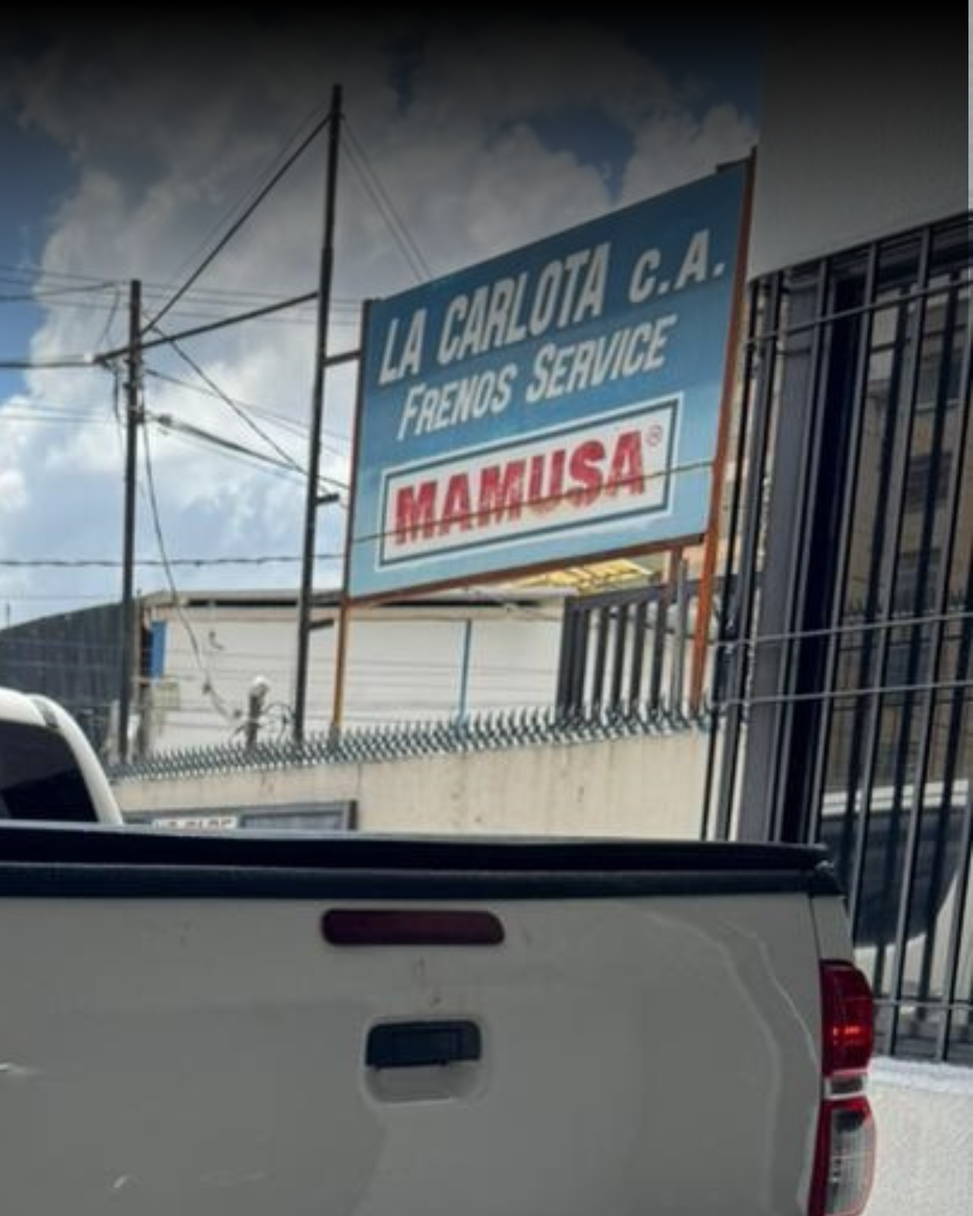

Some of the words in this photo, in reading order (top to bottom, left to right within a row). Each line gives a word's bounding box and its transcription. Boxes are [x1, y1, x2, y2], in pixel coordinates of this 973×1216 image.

[379, 309, 427, 386] LA
[437, 242, 611, 365] CARLOTA
[629, 229, 725, 303] C.A.
[398, 364, 517, 441] FRENOS
[526, 313, 677, 402] SERVICE
[395, 430, 645, 545] MAMUSA
